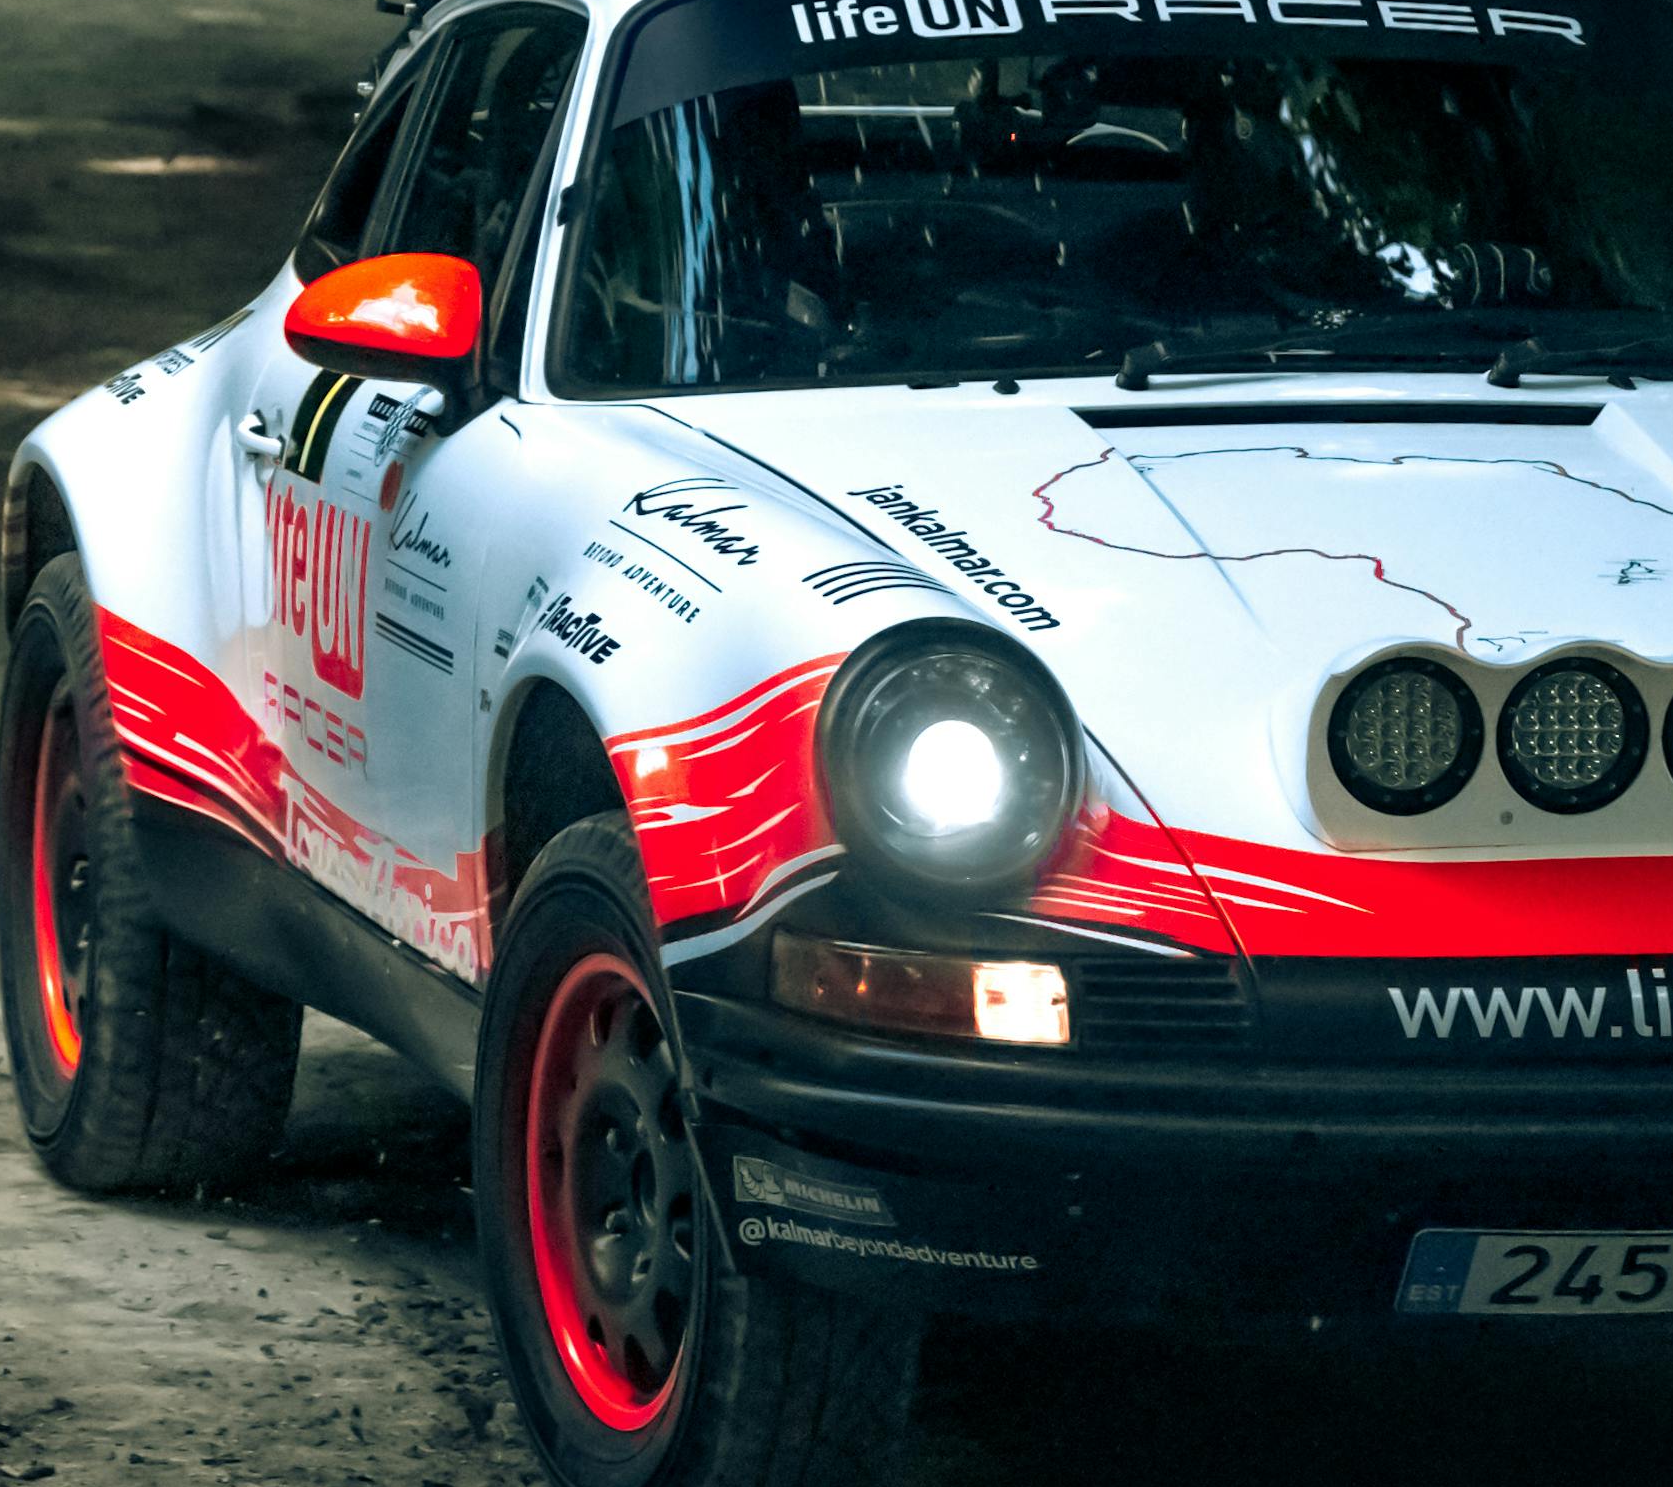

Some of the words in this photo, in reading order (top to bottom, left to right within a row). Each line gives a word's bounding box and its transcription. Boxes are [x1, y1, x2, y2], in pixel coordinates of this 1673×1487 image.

[390, 489, 452, 569] Kalmar
[623, 478, 759, 566] Kalmar
[847, 484, 1061, 632] jankalmar.com
[583, 541, 624, 568] BEYOND
[622, 564, 701, 624] ADVENTURE
[264, 670, 368, 780] RACER
[784, 1179, 881, 1214] MICHELIN
[738, 1216, 1039, 1270] @kalmarbeyondadventure
[1487, 1243, 1671, 1306] 245
[1407, 1283, 1462, 1302] EST
